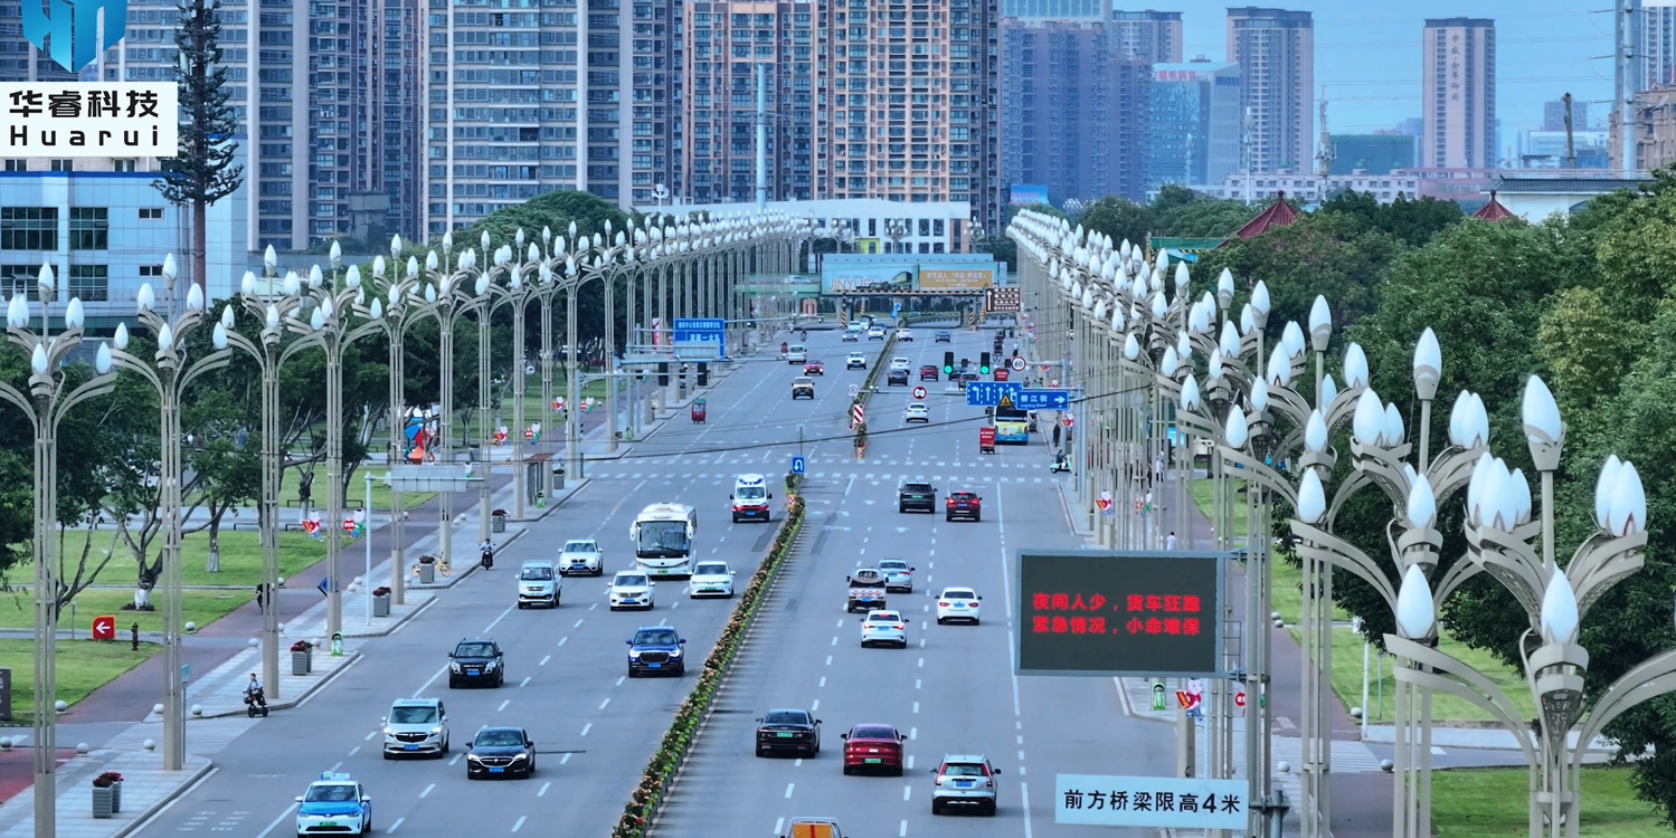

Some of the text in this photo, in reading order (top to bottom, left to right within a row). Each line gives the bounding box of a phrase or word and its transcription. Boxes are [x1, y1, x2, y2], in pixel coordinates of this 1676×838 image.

[1033, 592, 1201, 613] 夜间人少，货车狂跑
[1033, 616, 1200, 635] 紧急情况，小命难保
[1064, 789, 1240, 814] 前方桥梁限高4米
